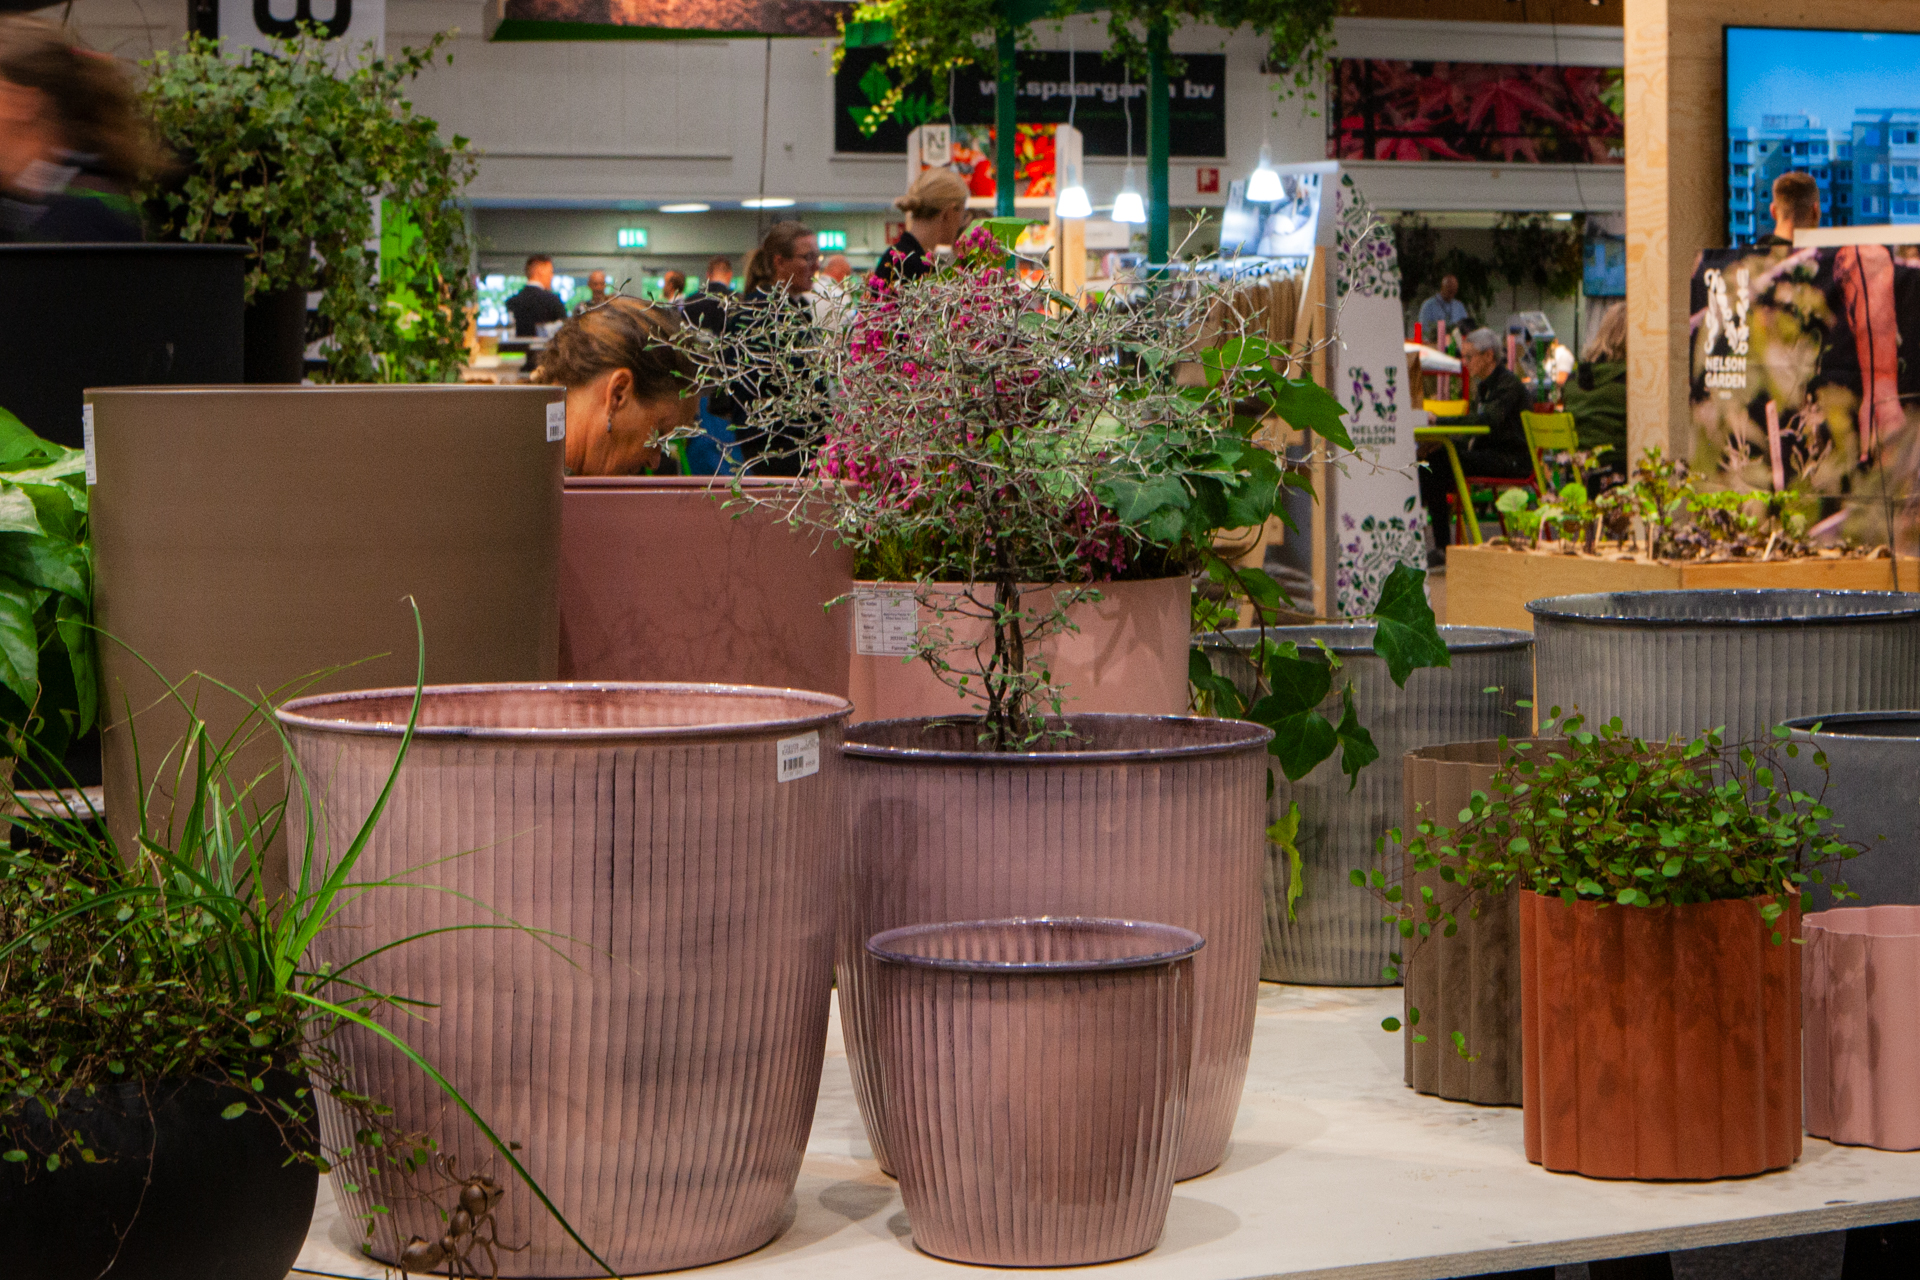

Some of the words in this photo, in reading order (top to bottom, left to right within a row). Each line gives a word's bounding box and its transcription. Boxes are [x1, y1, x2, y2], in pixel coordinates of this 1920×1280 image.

[1183, 80, 1215, 99] bv
[1705, 356, 1747, 371] NELSON
[1704, 372, 1747, 388] GARDEN
[1351, 425, 1396, 434] NELSON
[1352, 436, 1396, 445] GARDEN
